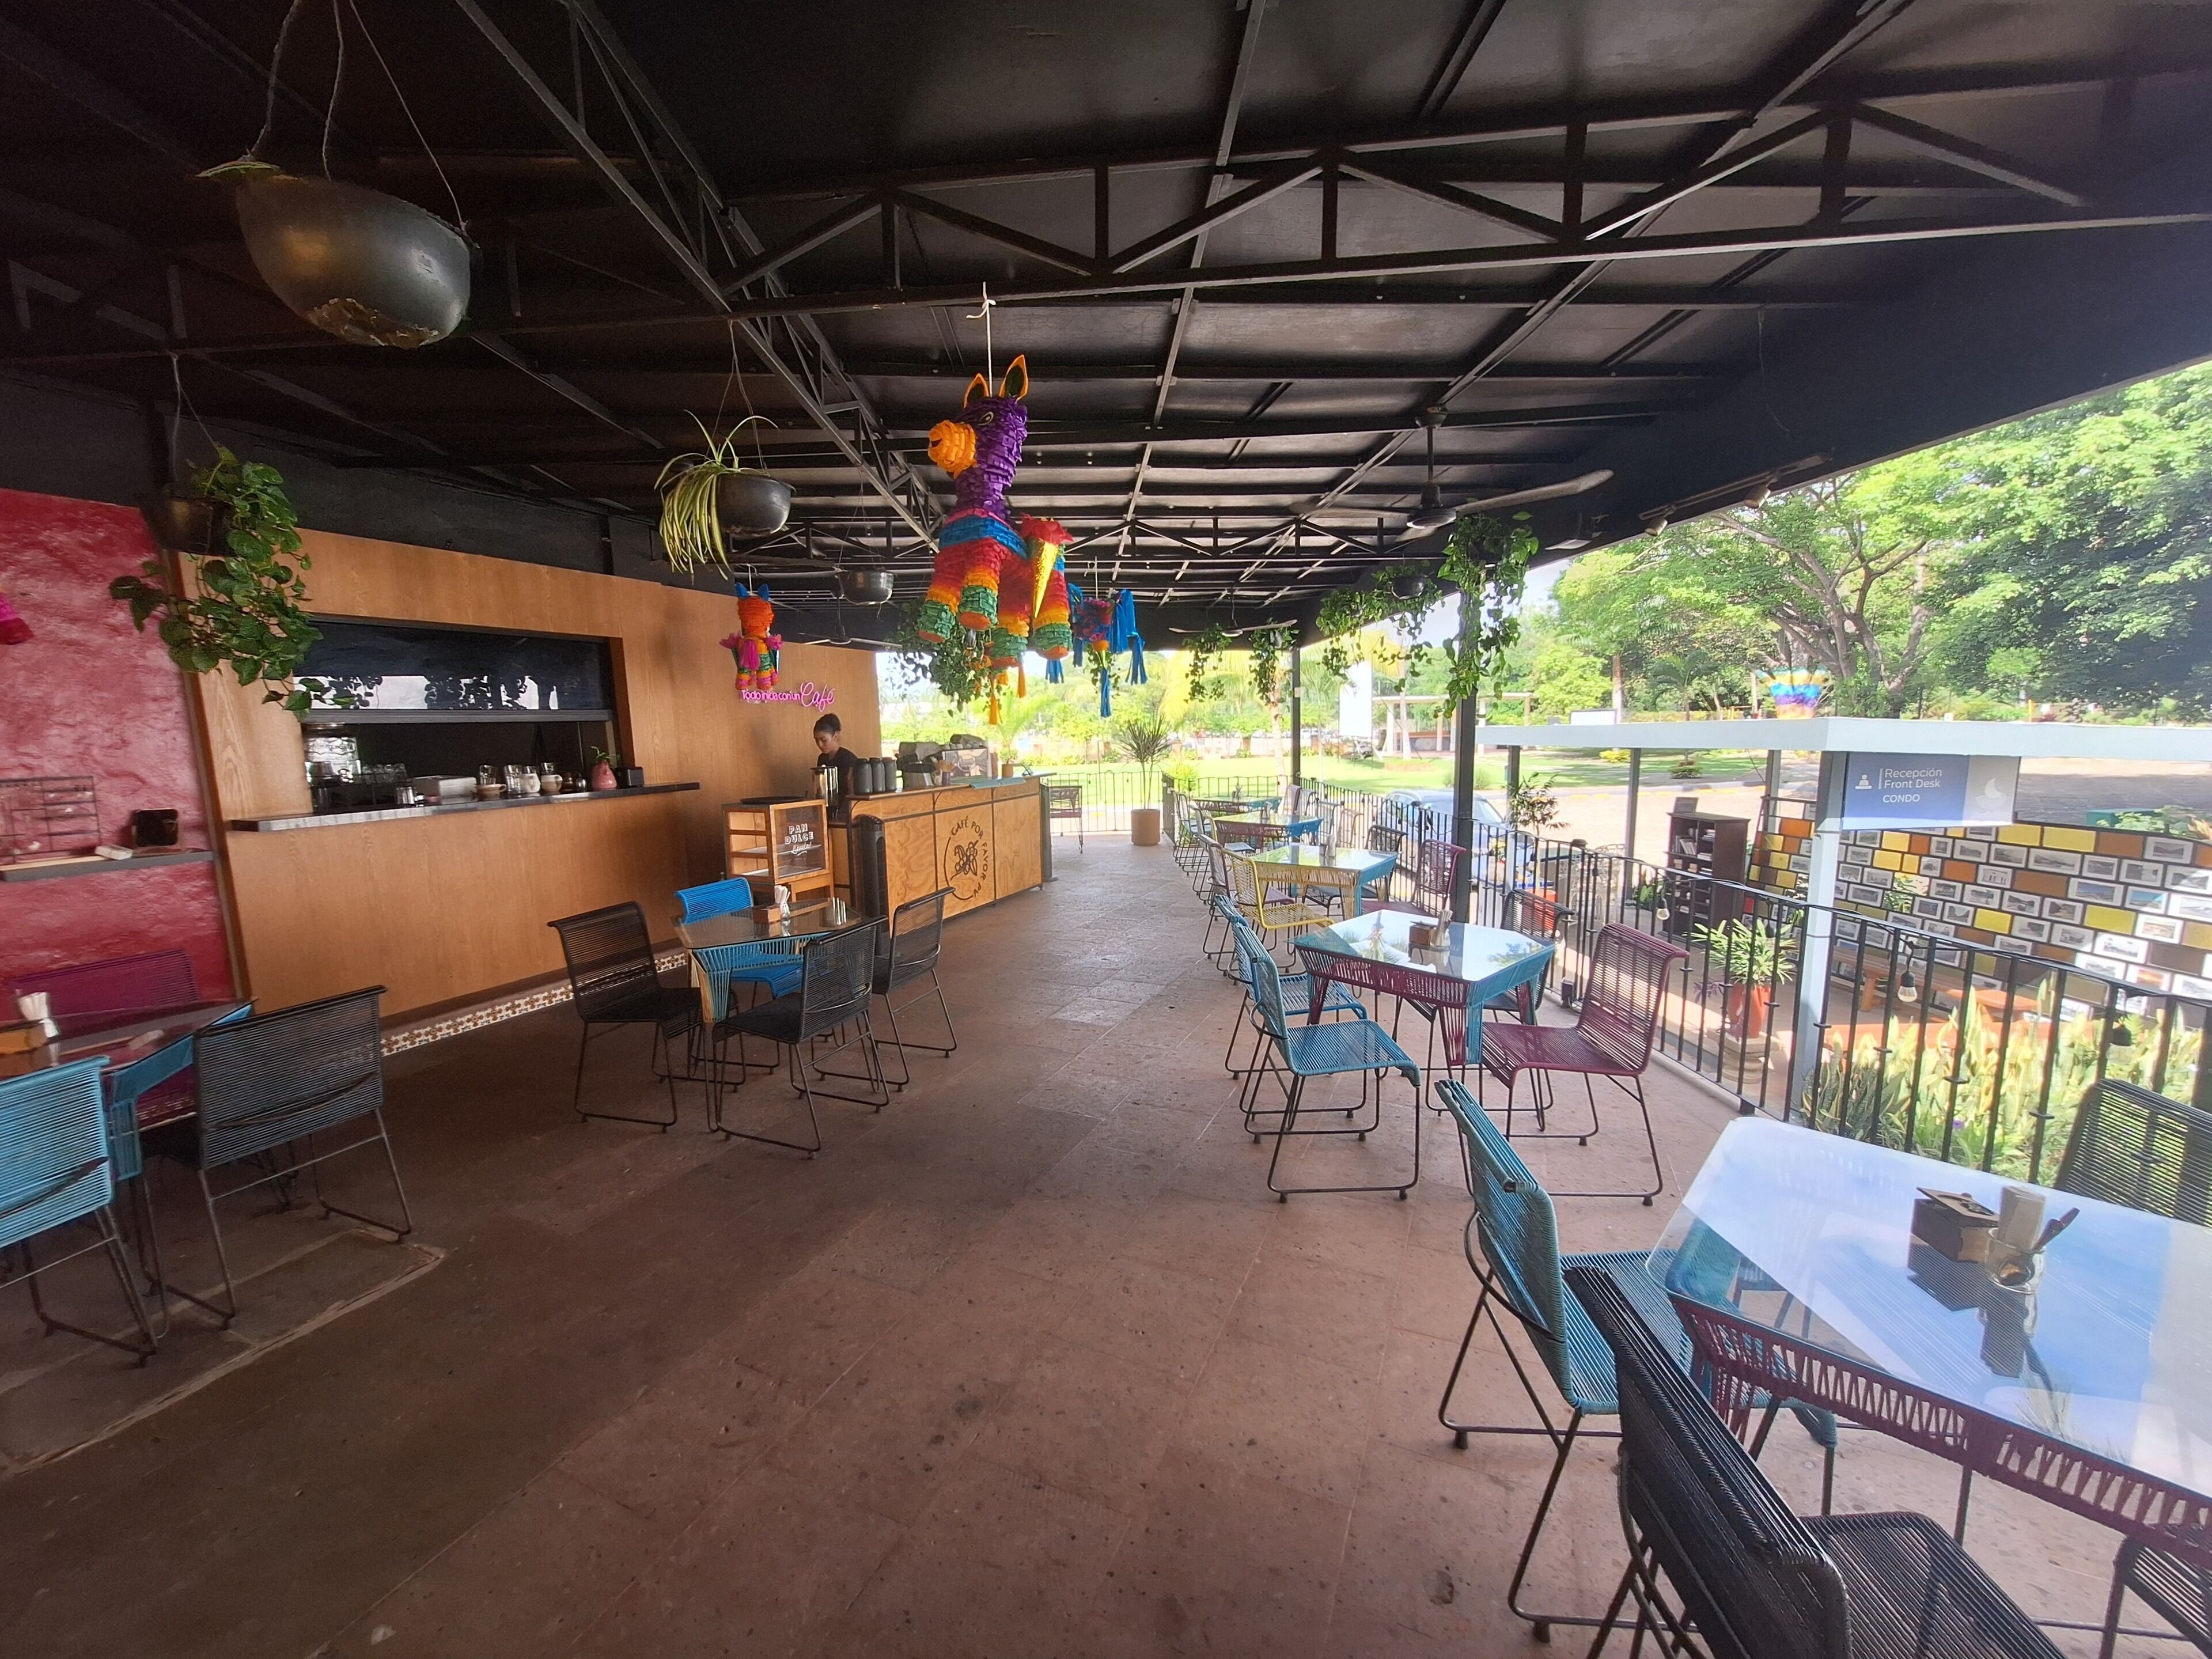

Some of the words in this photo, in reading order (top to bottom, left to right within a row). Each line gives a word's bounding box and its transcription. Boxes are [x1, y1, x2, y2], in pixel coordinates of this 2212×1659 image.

[741, 689, 761, 700] Todo
[762, 690, 778, 700] inicia
[778, 692, 791, 700] con
[792, 692, 800, 700] un
[800, 682, 836, 712] Café
[1885, 767, 1942, 779] Recepción
[1884, 779, 1913, 789] Front
[1915, 779, 1941, 788] Desk
[1883, 794, 1921, 803] CONDO
[789, 823, 808, 834] PAN
[951, 816, 968, 836] CAFÉ
[971, 821, 984, 840] POR
[785, 831, 813, 844] DULCE
[974, 882, 982, 897] PV
